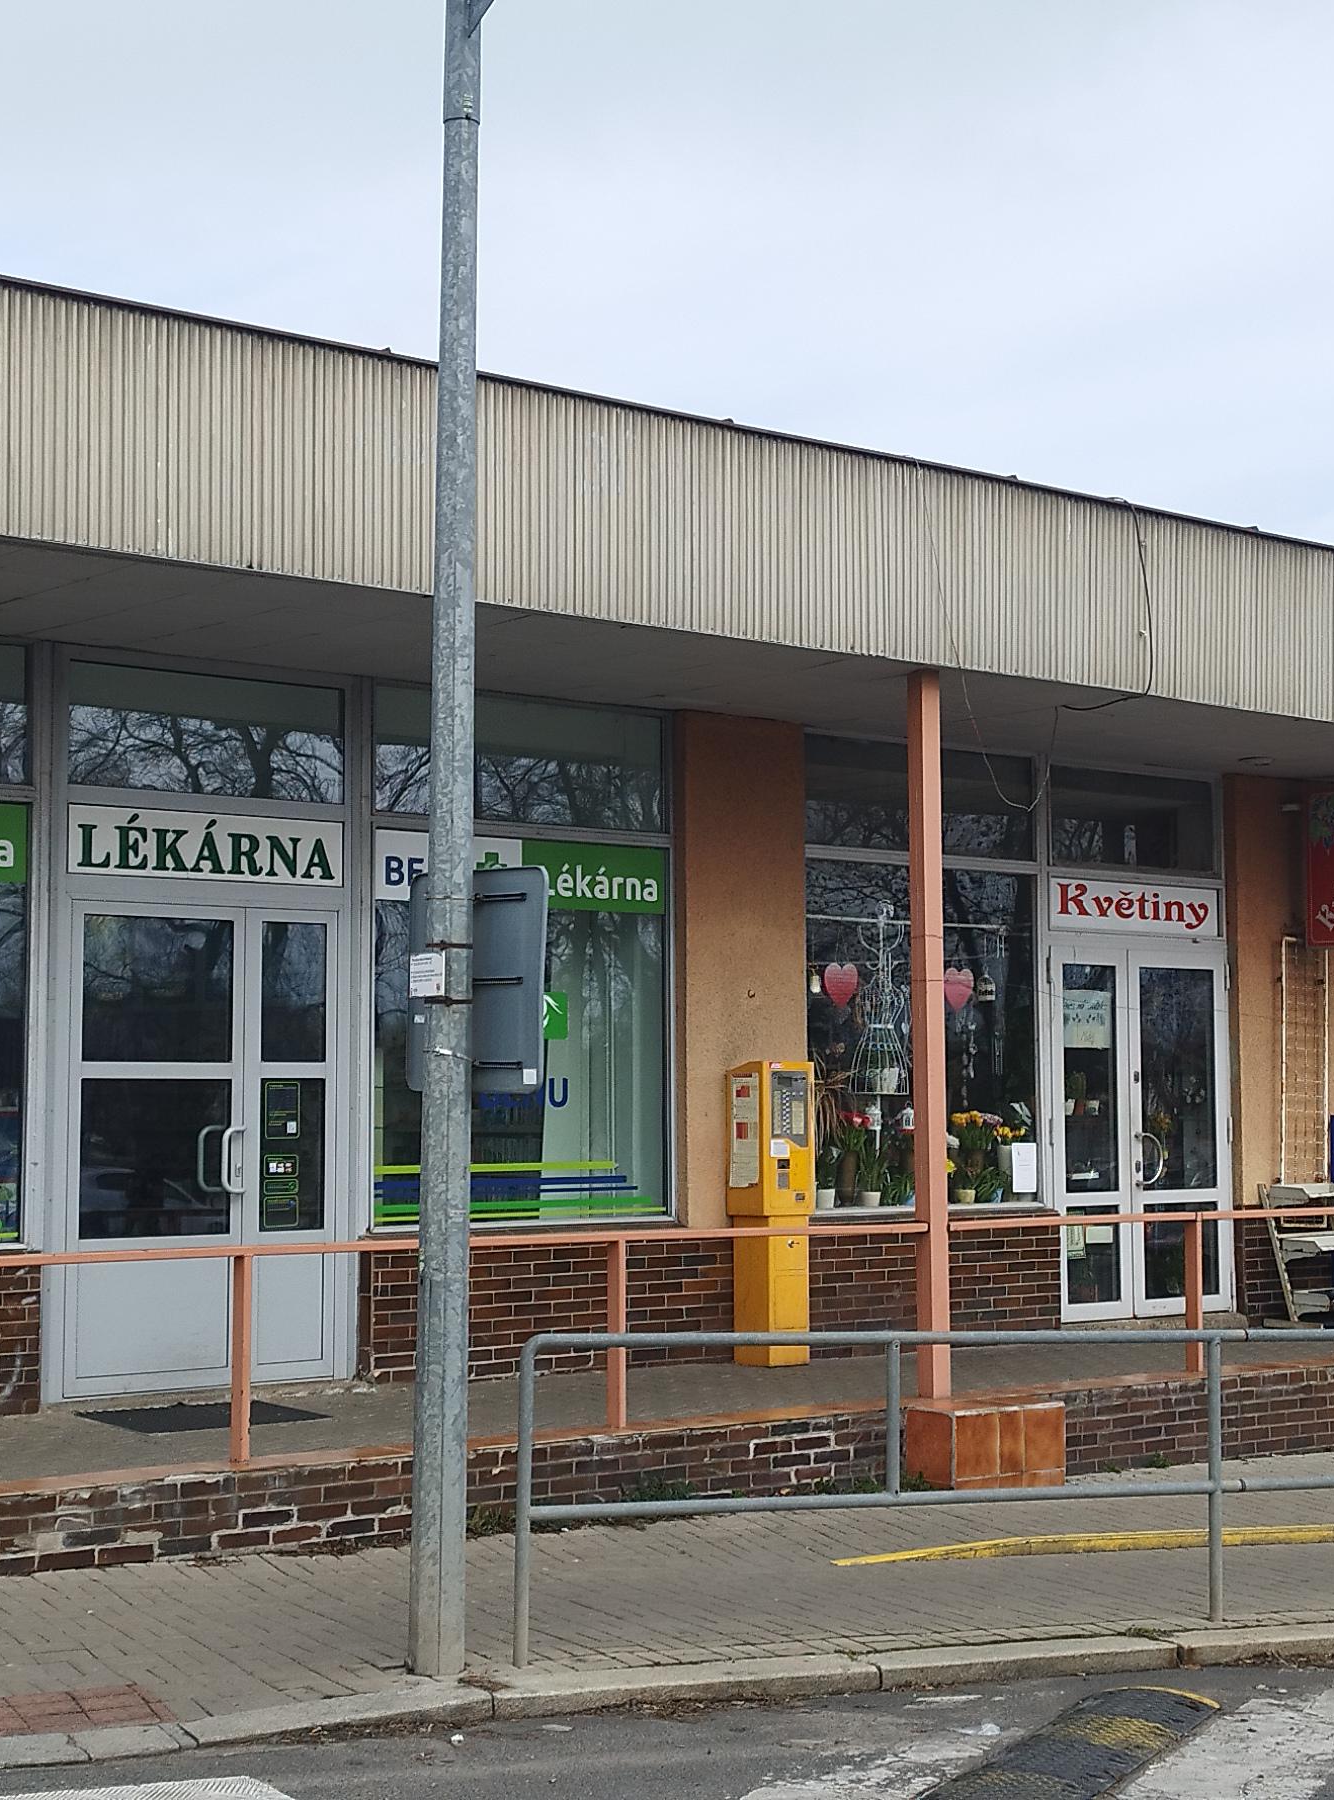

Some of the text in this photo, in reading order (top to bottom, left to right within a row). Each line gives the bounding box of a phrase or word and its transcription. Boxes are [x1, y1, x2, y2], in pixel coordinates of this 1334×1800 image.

[77, 813, 336, 881] LÉKÁRNA
[384, 855, 425, 887] BE
[548, 863, 658, 902] ékárna
[1057, 883, 1209, 930] Květiny
